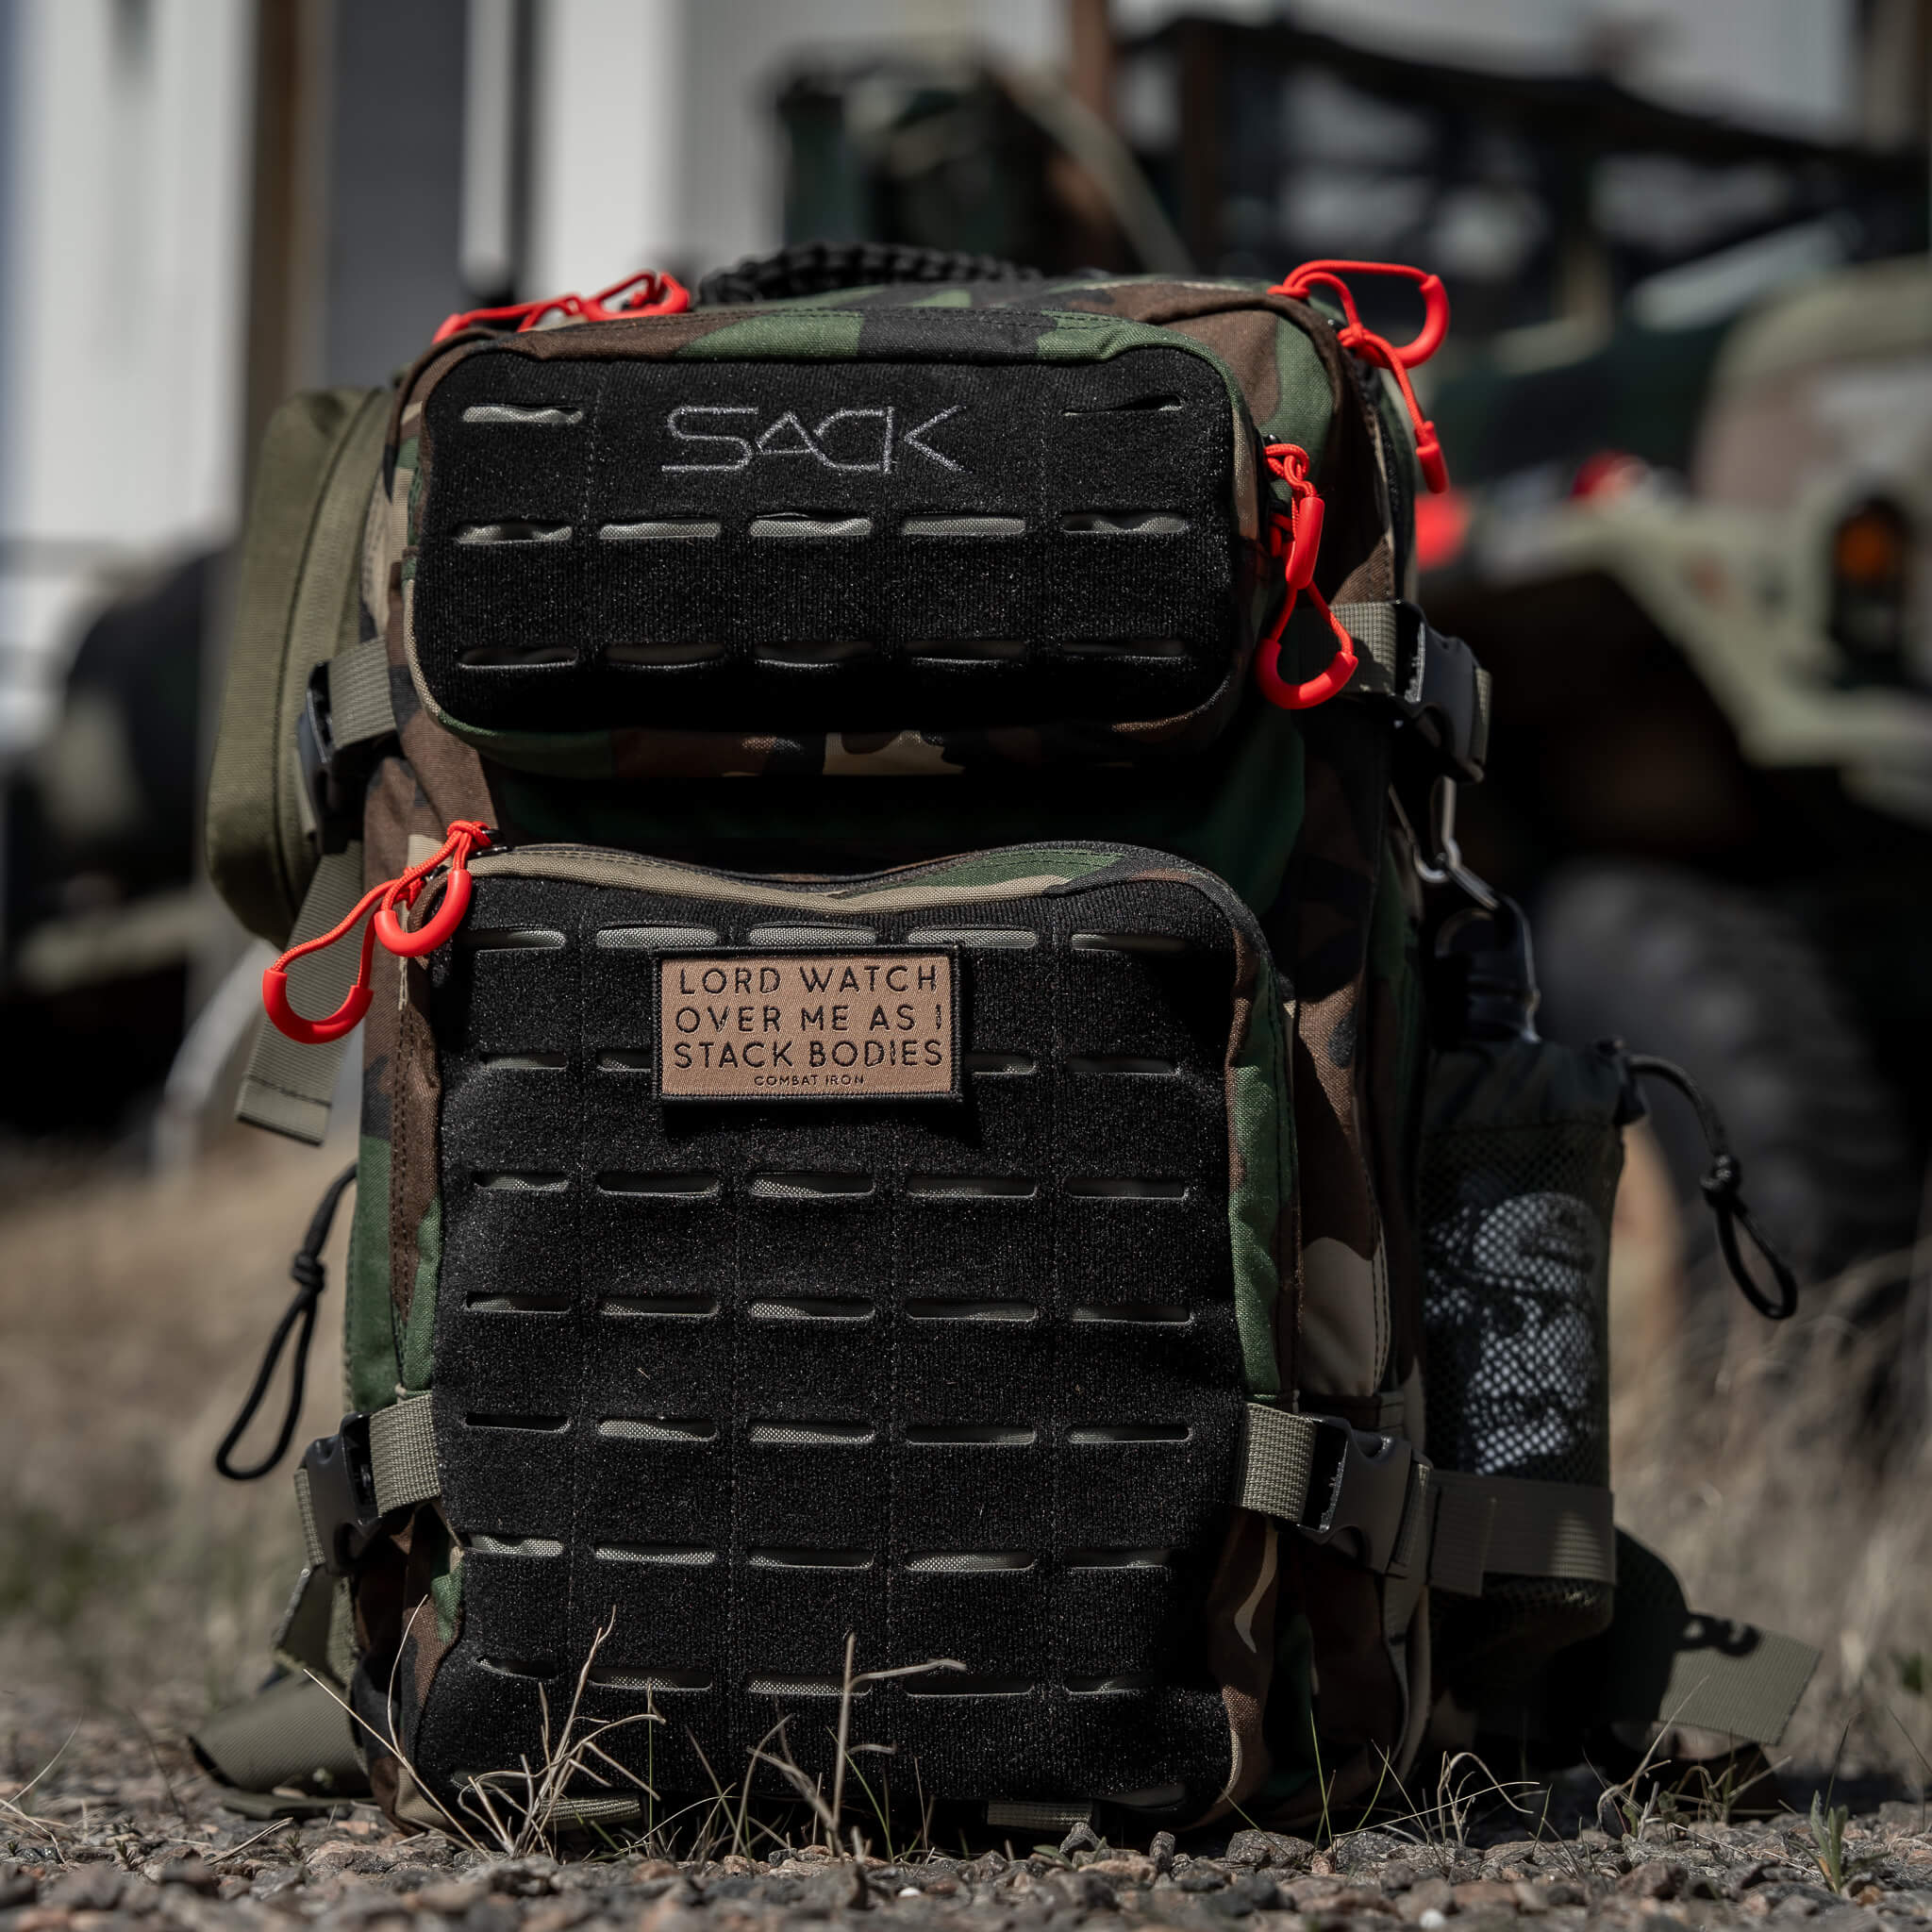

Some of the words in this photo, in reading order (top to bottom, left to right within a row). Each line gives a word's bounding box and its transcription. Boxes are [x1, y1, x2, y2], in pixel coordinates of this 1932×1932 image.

[661, 406, 969, 474] SACK
[679, 967, 781, 995] LORD
[800, 964, 937, 993] WATCH
[675, 1005, 781, 1033] OVER
[801, 1005, 849, 1031] ME
[869, 1004, 915, 1031] AS
[935, 1003, 942, 1030] I
[674, 1040, 793, 1069] STACK
[808, 1040, 943, 1068] BODIES
[754, 1074, 818, 1087] COMBAT
[824, 1074, 864, 1086] IRON
